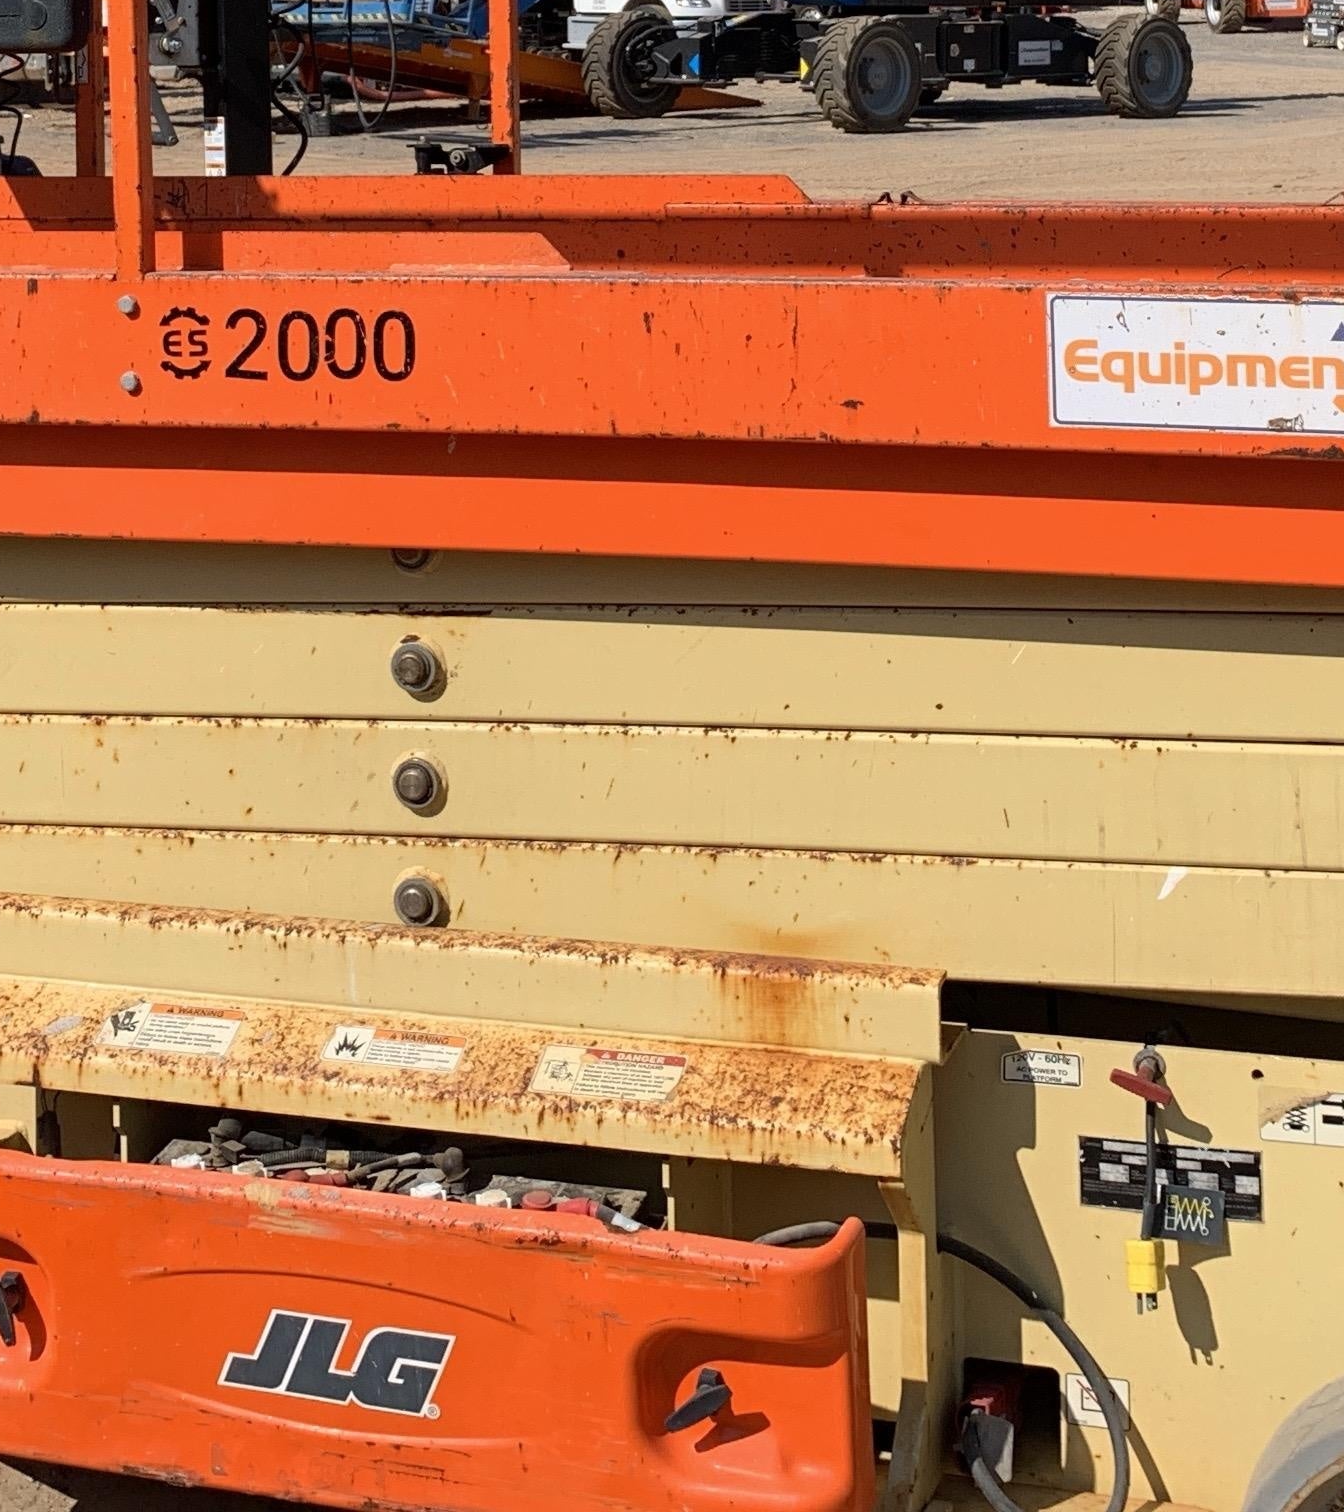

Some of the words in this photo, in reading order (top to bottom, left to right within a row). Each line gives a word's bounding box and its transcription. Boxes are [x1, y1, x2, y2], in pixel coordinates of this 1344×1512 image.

[225, 308, 416, 382] 2000
[177, 1007, 225, 1018] WARNING
[400, 1033, 449, 1045] WARNING
[616, 1051, 666, 1064] DANGER
[1044, 1054, 1071, 1065] 60Hz
[1028, 1067, 1056, 1075] POWER
[1022, 1074, 1062, 1083] PLATFORM
[217, 1308, 457, 1418] JLG
